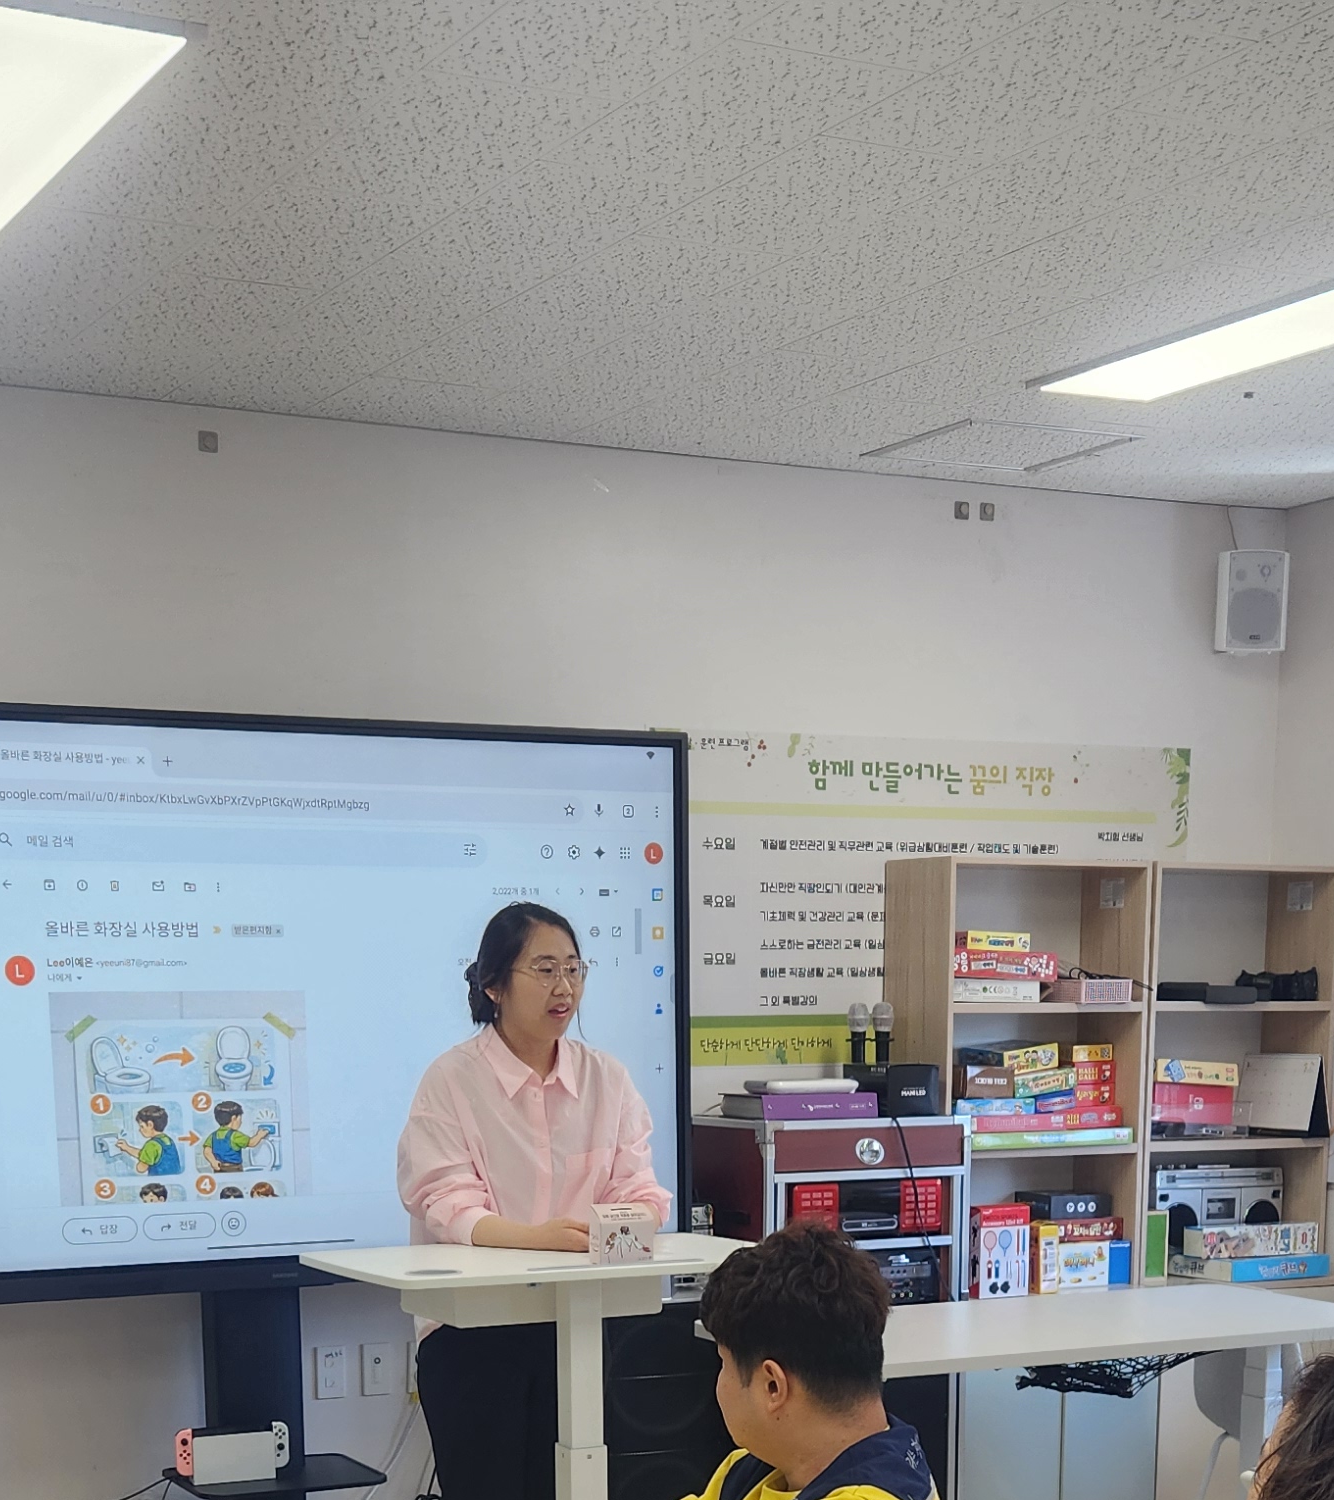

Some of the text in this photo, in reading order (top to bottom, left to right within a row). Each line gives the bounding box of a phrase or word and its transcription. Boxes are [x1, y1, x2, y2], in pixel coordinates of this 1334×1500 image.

[717, 738, 749, 751] 프로그램
[0, 749, 30, 762] 올바른
[32, 750, 63, 764] 화장실
[807, 759, 1055, 797] 함께 만들어가는 꿈의 직장
[26, 834, 74, 849] 메일 검색
[702, 837, 736, 851] 수요일
[760, 839, 787, 851] 계절별
[789, 840, 826, 852] 안전관리
[827, 840, 837, 852] 및
[838, 841, 874, 853] 직무관련
[875, 841, 894, 853] 교육
[759, 882, 885, 895] 자신만만 직장인되기 (대인관계
[702, 895, 736, 909] 목요일
[759, 911, 796, 923] 기초체력
[798, 911, 807, 923] 및
[809, 911, 845, 923] 건강관리
[846, 912, 864, 923] 교육
[44, 920, 199, 939] 올바른 화장실 사용방법
[234, 925, 272, 936] 받은편지함
[759, 939, 804, 950] 스스로하는
[806, 939, 842, 950] 금전관리
[844, 939, 861, 950] 교육
[702, 952, 736, 965] 금요일
[15, 965, 25, 978] L
[46, 973, 73, 983] 나에게
[759, 967, 787, 978] 올바른
[788, 967, 824, 979] 직장생활
[826, 967, 844, 978] 교육
[759, 995, 818, 1007] 그 외 특별강의
[700, 1038, 742, 1053] 단순하게
[744, 1037, 788, 1051] 단단하게
[196, 1096, 207, 1108] 2
[100, 1179, 212, 1196] 3 4
[99, 1223, 118, 1236] 답장
[178, 1219, 198, 1231] 전달
